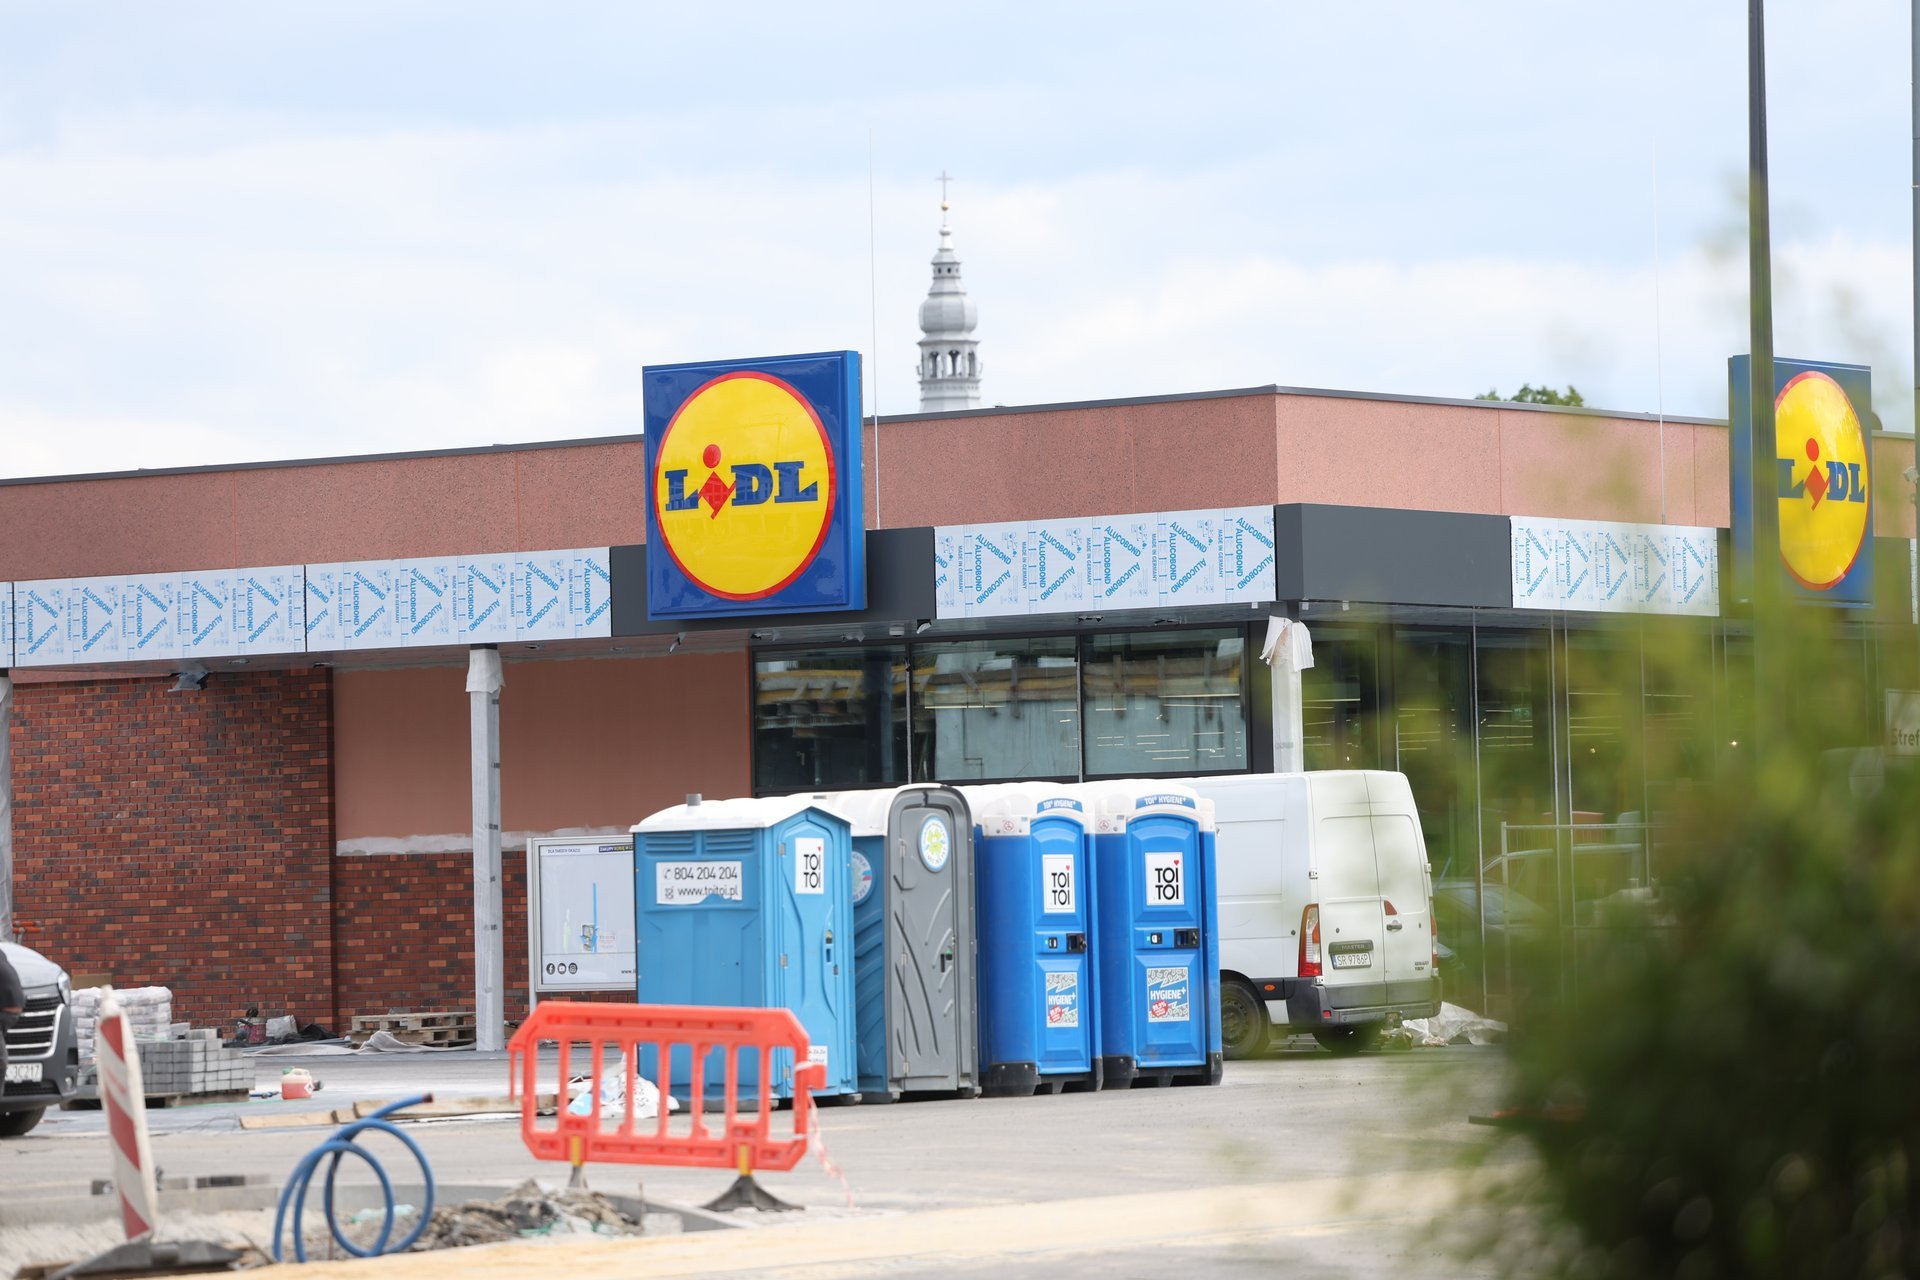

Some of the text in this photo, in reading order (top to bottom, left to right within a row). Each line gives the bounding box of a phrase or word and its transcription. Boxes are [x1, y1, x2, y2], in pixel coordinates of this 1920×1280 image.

[1040, 530, 1076, 560] ALUCOBOND
[1104, 526, 1141, 556] ALUCOBOND
[1170, 522, 1207, 552] ALUCOBOND
[1236, 518, 1274, 549] ALUCOBOND
[976, 534, 1012, 564] ALUCOBOND
[1040, 566, 1076, 600] ALUCOBOND
[1105, 562, 1140, 597] ALUCOBOND
[1171, 558, 1206, 593] ALUCOBOND
[1237, 554, 1274, 589] ALUCOBOND
[976, 570, 1011, 604] ALUCOBOND
[674, 866, 737, 880] 804 204 204
[804, 854, 821, 870] TOI
[804, 872, 821, 888] TOI
[1052, 872, 1070, 888] TOI
[1155, 867, 1179, 883] TOI
[1052, 890, 1070, 905] TOI
[1155, 884, 1179, 900] TOI
[1337, 954, 1368, 966] SR 9786P
[1048, 992, 1076, 1005] HYGIENE+
[1150, 986, 1186, 1000] HYGIENE+
